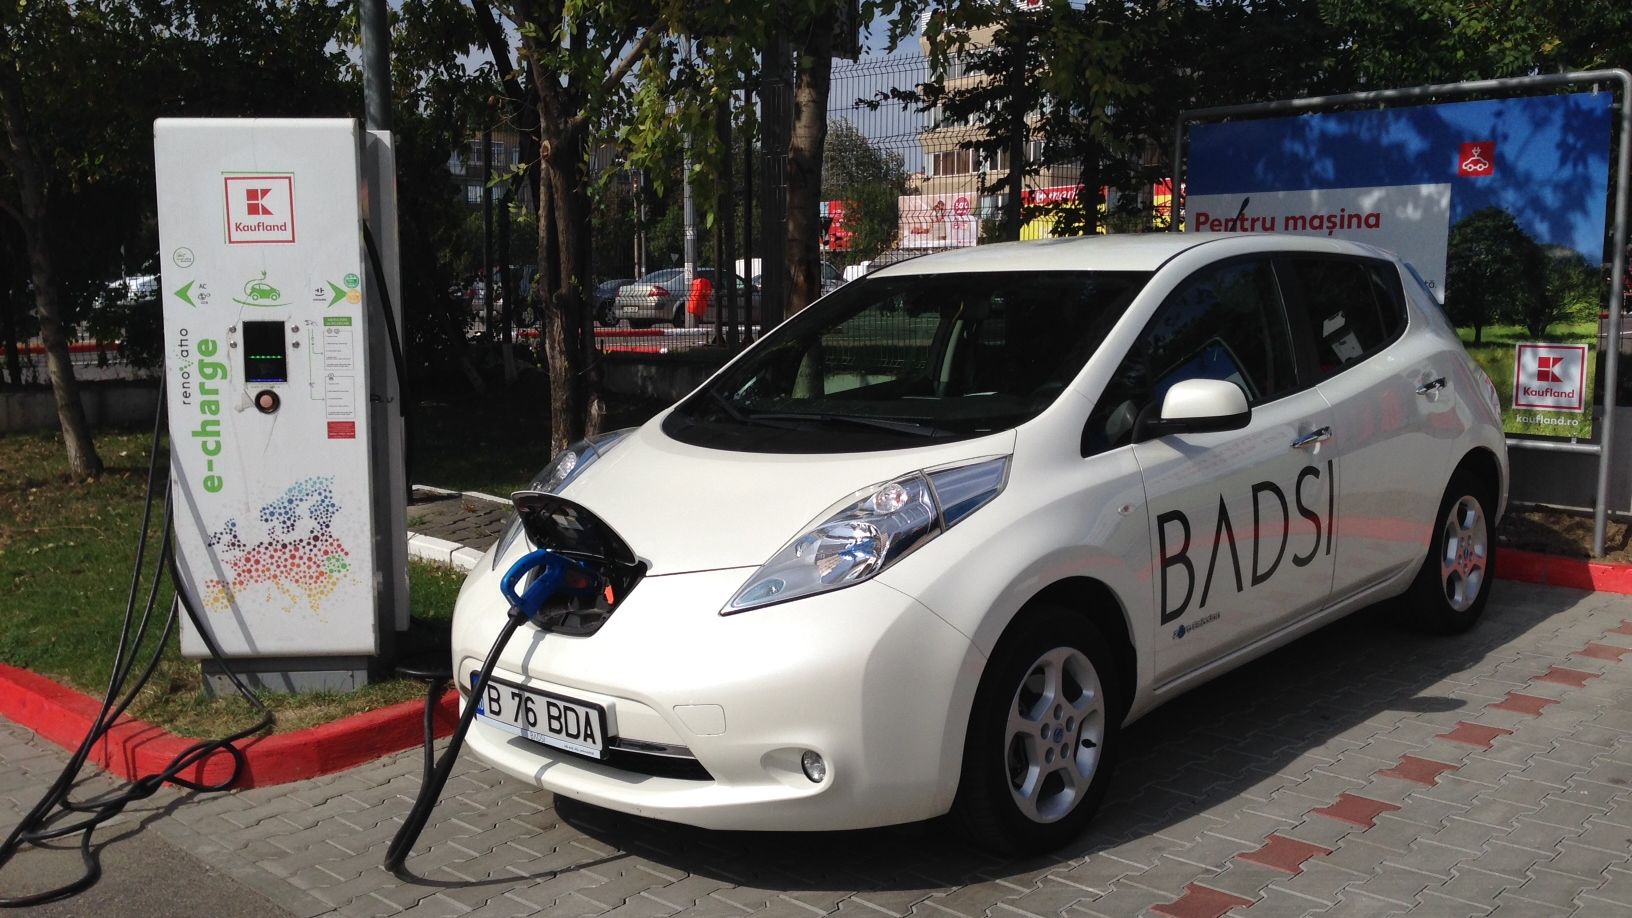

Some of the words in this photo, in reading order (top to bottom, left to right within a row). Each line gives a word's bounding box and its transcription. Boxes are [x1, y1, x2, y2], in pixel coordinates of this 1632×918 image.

[235, 222, 287, 233] Kaufland
[1195, 211, 1276, 232] Pentru
[1284, 208, 1381, 236] mașina
[1523, 387, 1574, 399] Kaufland
[191, 338, 228, 493] e-charge
[1516, 414, 1579, 426] kaufland.ro
[1156, 459, 1335, 627] BADSI
[487, 683, 502, 716] B
[511, 691, 538, 728] 76
[546, 700, 596, 745] BDA
